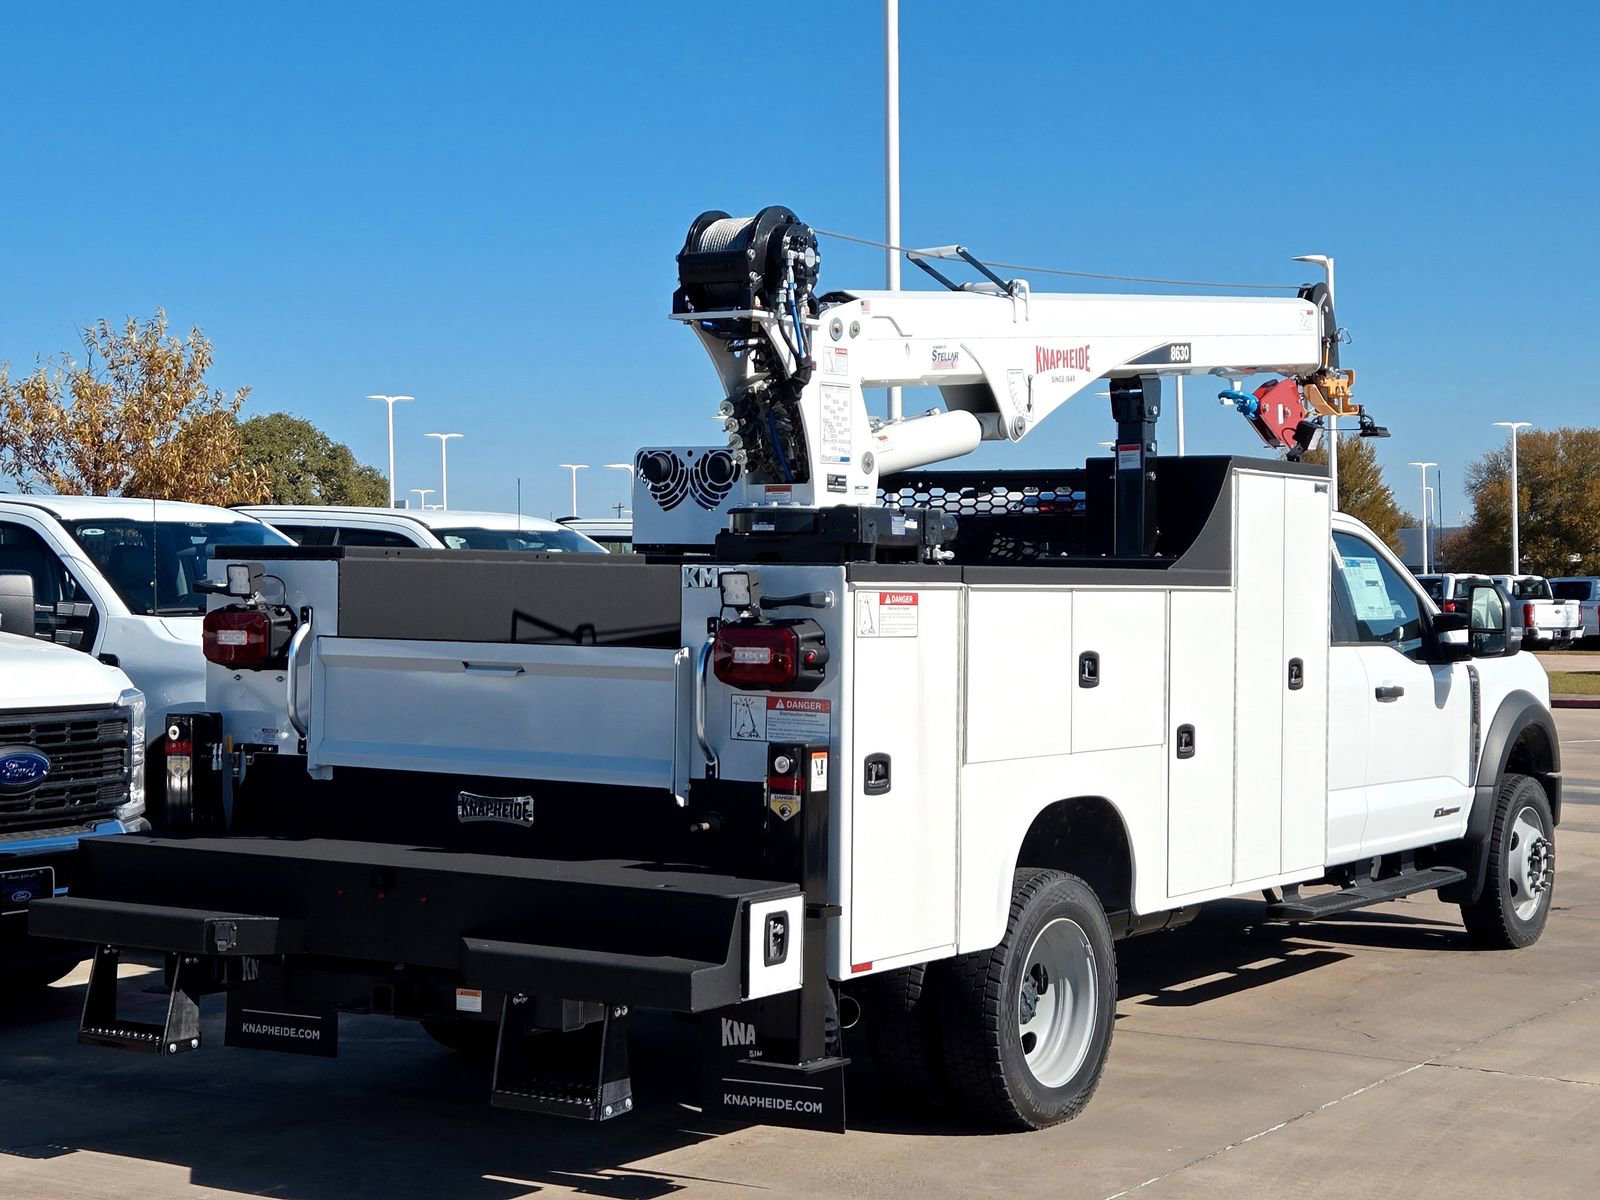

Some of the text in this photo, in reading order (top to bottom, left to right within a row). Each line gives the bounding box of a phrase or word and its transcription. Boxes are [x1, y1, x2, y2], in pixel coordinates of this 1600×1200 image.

[1036, 345, 1090, 374] KNAPHEIDE
[1170, 345, 1190, 361] 8630
[891, 595, 913, 603] DANGER
[786, 700, 821, 710] DANGER
[461, 795, 532, 822] KNAPHEIDE
[242, 1023, 321, 1040] KNAPHEIDE.COM
[723, 1093, 823, 1114] KNAPHEIDE.COM
